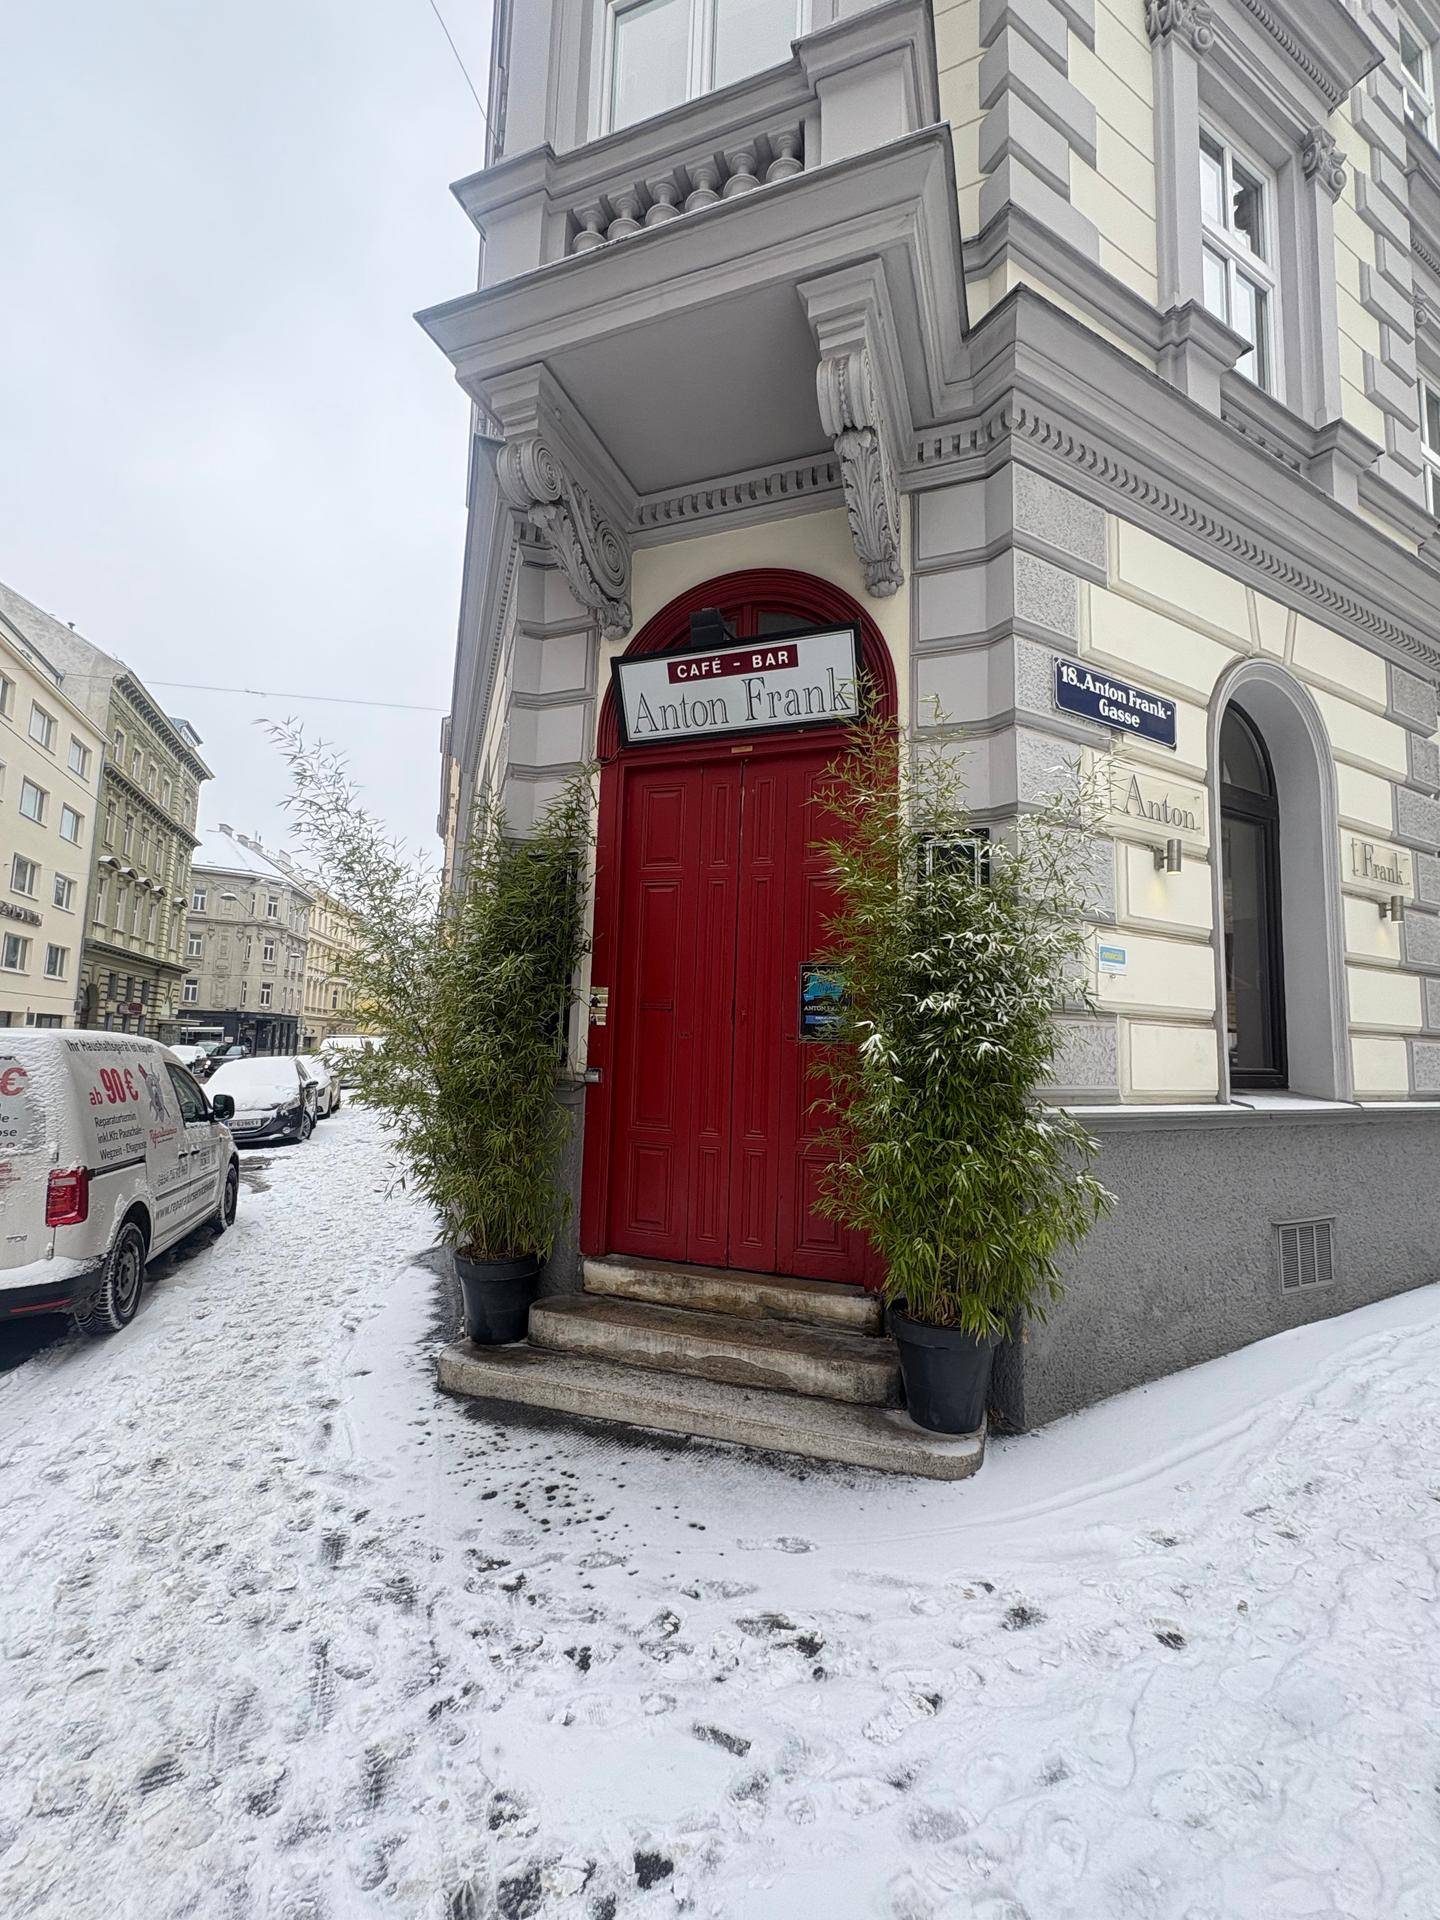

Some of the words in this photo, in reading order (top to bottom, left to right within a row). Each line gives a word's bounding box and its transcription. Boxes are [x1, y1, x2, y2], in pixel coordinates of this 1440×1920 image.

[676, 657, 722, 679] CAFÉ
[752, 650, 789, 669] BAR
[633, 692, 730, 734] Anton
[741, 667, 850, 722] Frank
[1082, 673, 1126, 704] Anton
[1128, 689, 1172, 719] Frank-
[1098, 698, 1141, 728] Gasse
[1121, 774, 1198, 830] Anton
[1361, 842, 1404, 886] Frank
[65, 1039, 80, 1052] Ihr
[89, 1086, 103, 1105] ab
[100, 1145, 122, 1160] Wegzeit
